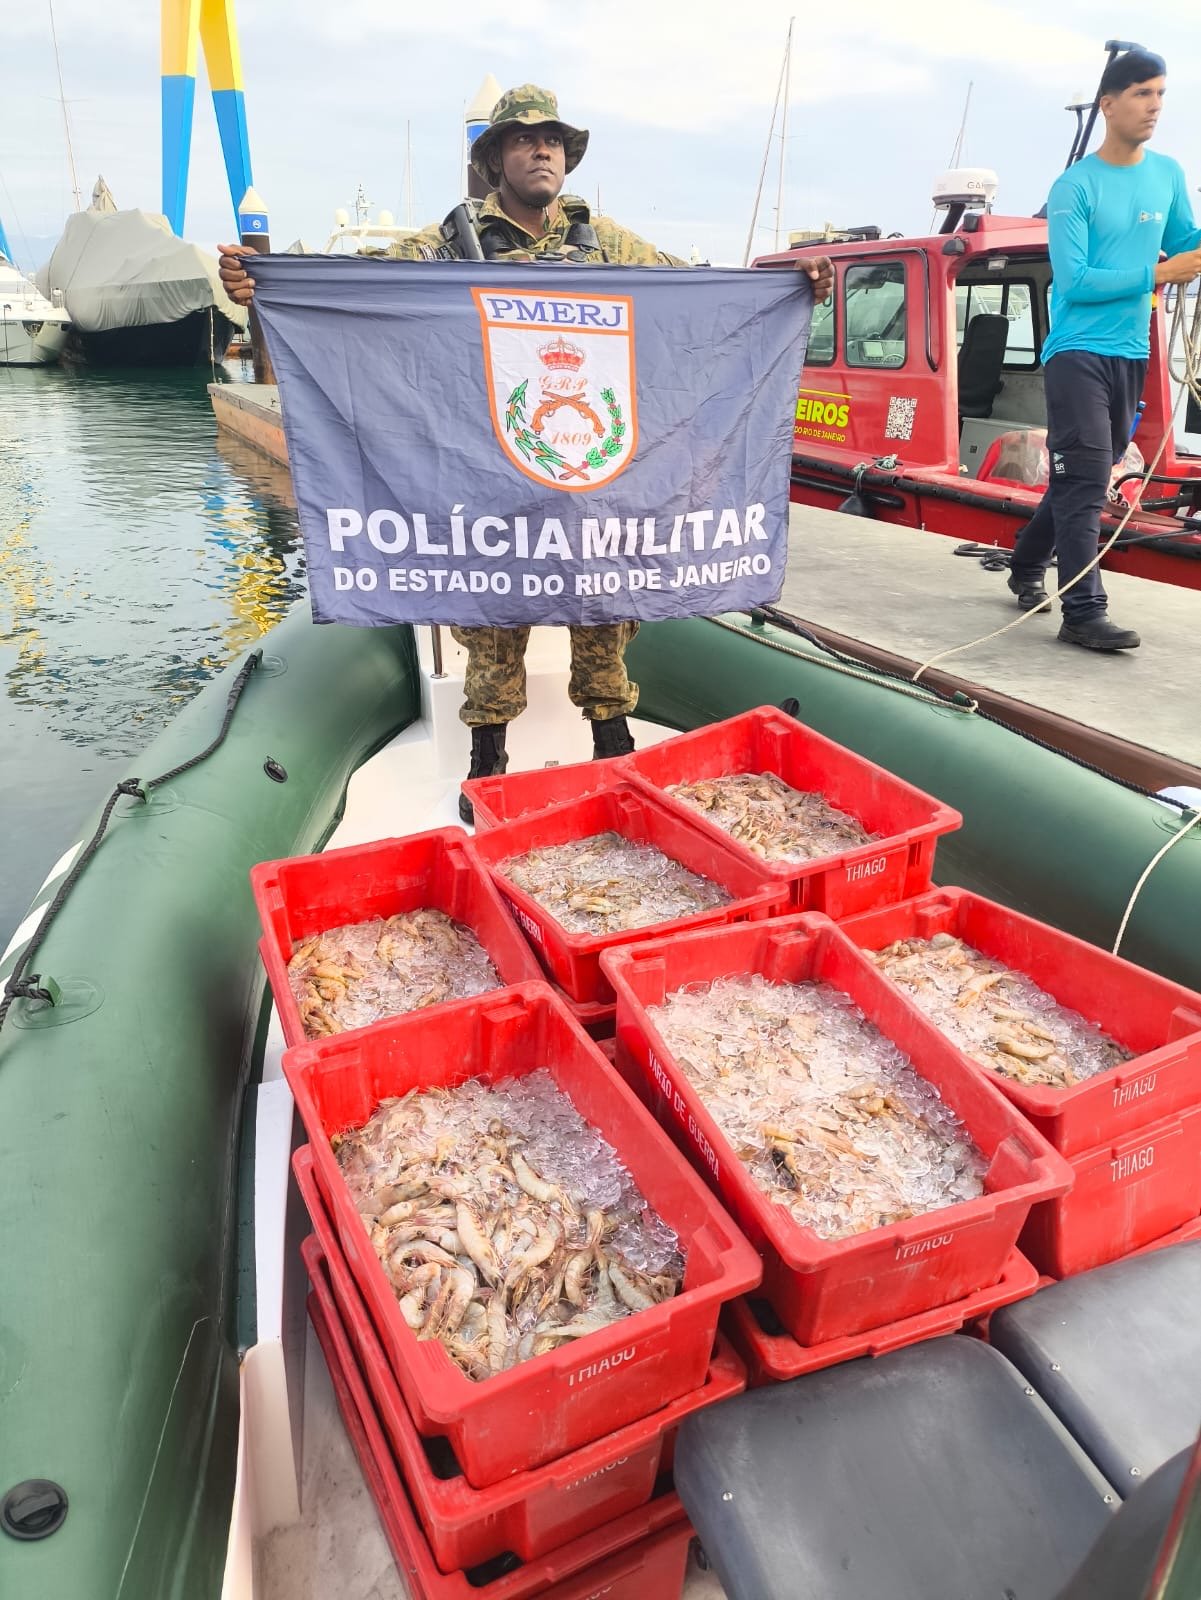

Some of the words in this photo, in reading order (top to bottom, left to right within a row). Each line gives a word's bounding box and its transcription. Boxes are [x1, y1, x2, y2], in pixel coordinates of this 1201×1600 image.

[487, 298, 623, 327] PMERJ
[551, 431, 592, 446] 1809
[326, 504, 574, 561] POLÍCIA
[581, 502, 769, 560] MILITAR
[333, 567, 378, 592] DO
[388, 568, 512, 595] ESTADO
[522, 573, 565, 597] DO
[575, 571, 621, 596] RIO
[628, 567, 662, 591] DE
[669, 553, 771, 588] JANEIRO
[846, 857, 887, 882] THIAGO
[1113, 1074, 1157, 1108] THIAGO
[673, 1091, 687, 1122] DE
[688, 1114, 719, 1181] GUERRA
[1110, 1146, 1155, 1182] THIAGO
